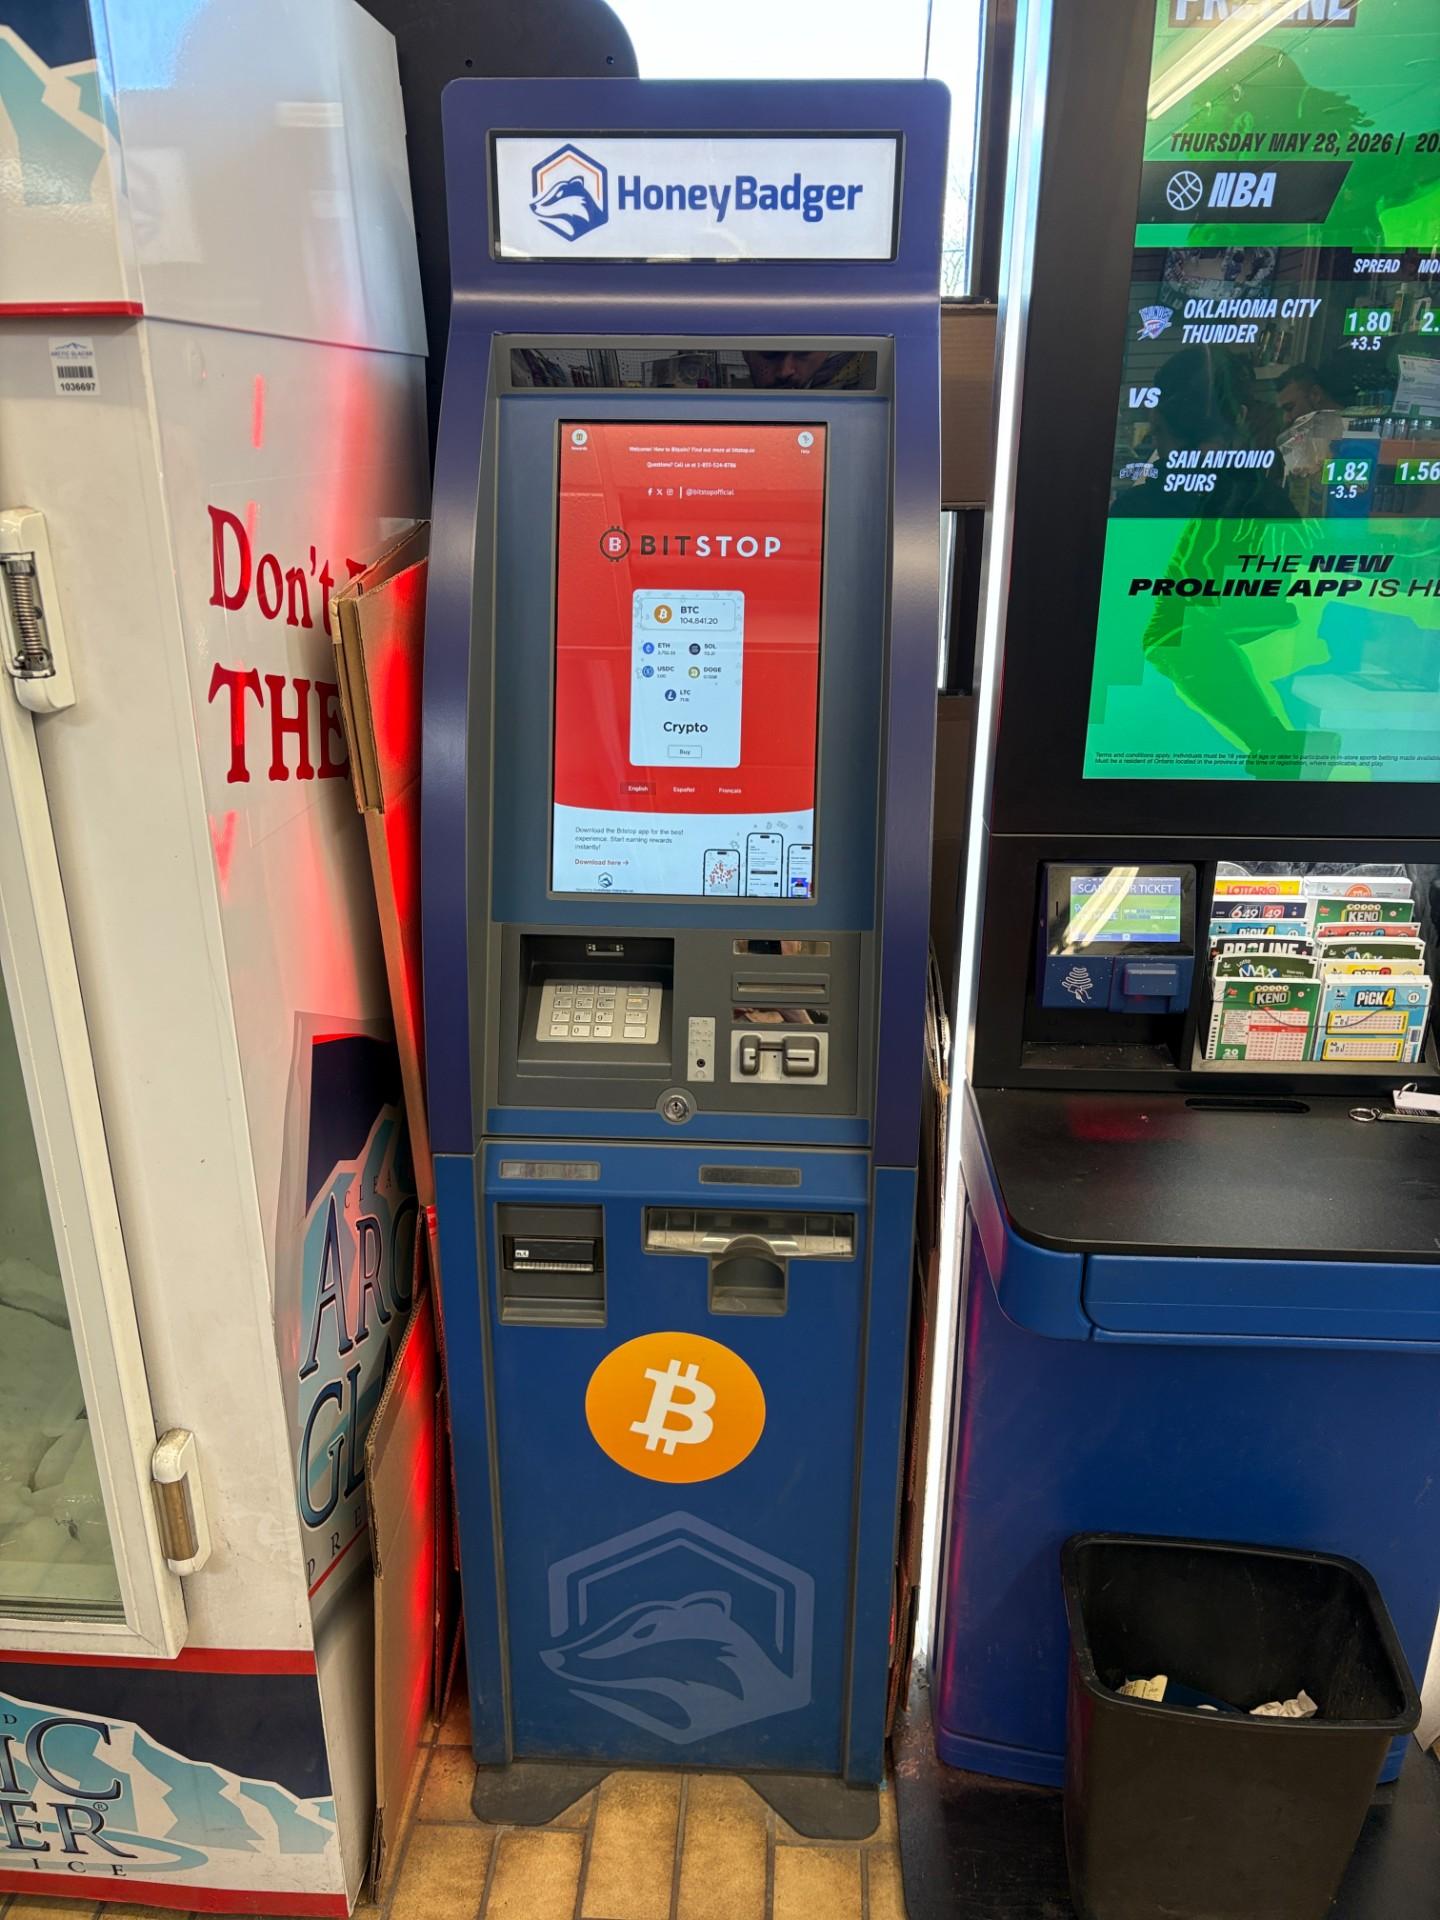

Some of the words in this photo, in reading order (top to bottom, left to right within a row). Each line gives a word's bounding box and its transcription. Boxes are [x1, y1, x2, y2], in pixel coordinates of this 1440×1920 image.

[1171, 132, 1266, 153] THURSDAY
[1268, 132, 1311, 153] MAY
[1315, 132, 1340, 157] 28,
[1349, 132, 1391, 153] 2026
[1415, 132, 1440, 153] 20
[617, 173, 863, 223] HoneyBadger
[1207, 172, 1277, 208] NBA
[1353, 258, 1401, 274] SPREAD
[1417, 259, 1440, 274] MO
[1183, 299, 1278, 319] OKLAHOMA
[1280, 299, 1322, 319] CITY
[1348, 311, 1391, 333] 1.80
[1181, 324, 1259, 344] THUNDER
[1350, 336, 1381, 351] +3.5
[1128, 387, 1161, 408] VS
[1166, 450, 1199, 469] SAN
[1201, 450, 1275, 469] ANTONIO
[1325, 461, 1369, 482] 1.82
[1163, 474, 1217, 492] SPURS
[1329, 485, 1358, 499] -3.5
[640, 535, 781, 557] BITSTOP
[207, 505, 334, 636] Don't
[1237, 554, 1302, 573] THE
[1308, 554, 1394, 573] NEW
[1127, 578, 1283, 597] PROLINE
[1285, 578, 1362, 597] APP
[1368, 578, 1400, 597] IS
[680, 606, 700, 614] BTC
[208, 662, 350, 784] THE
[663, 721, 709, 734] Crypto
[628, 785, 649, 793] English
[1140, 884, 1174, 894] TICKET
[1348, 911, 1379, 922] KENO
[1256, 992, 1287, 1005] KENO
[300, 1191, 419, 1381] ARC
[0, 1717, 122, 1801] IC
[0, 1800, 139, 1859] ER
